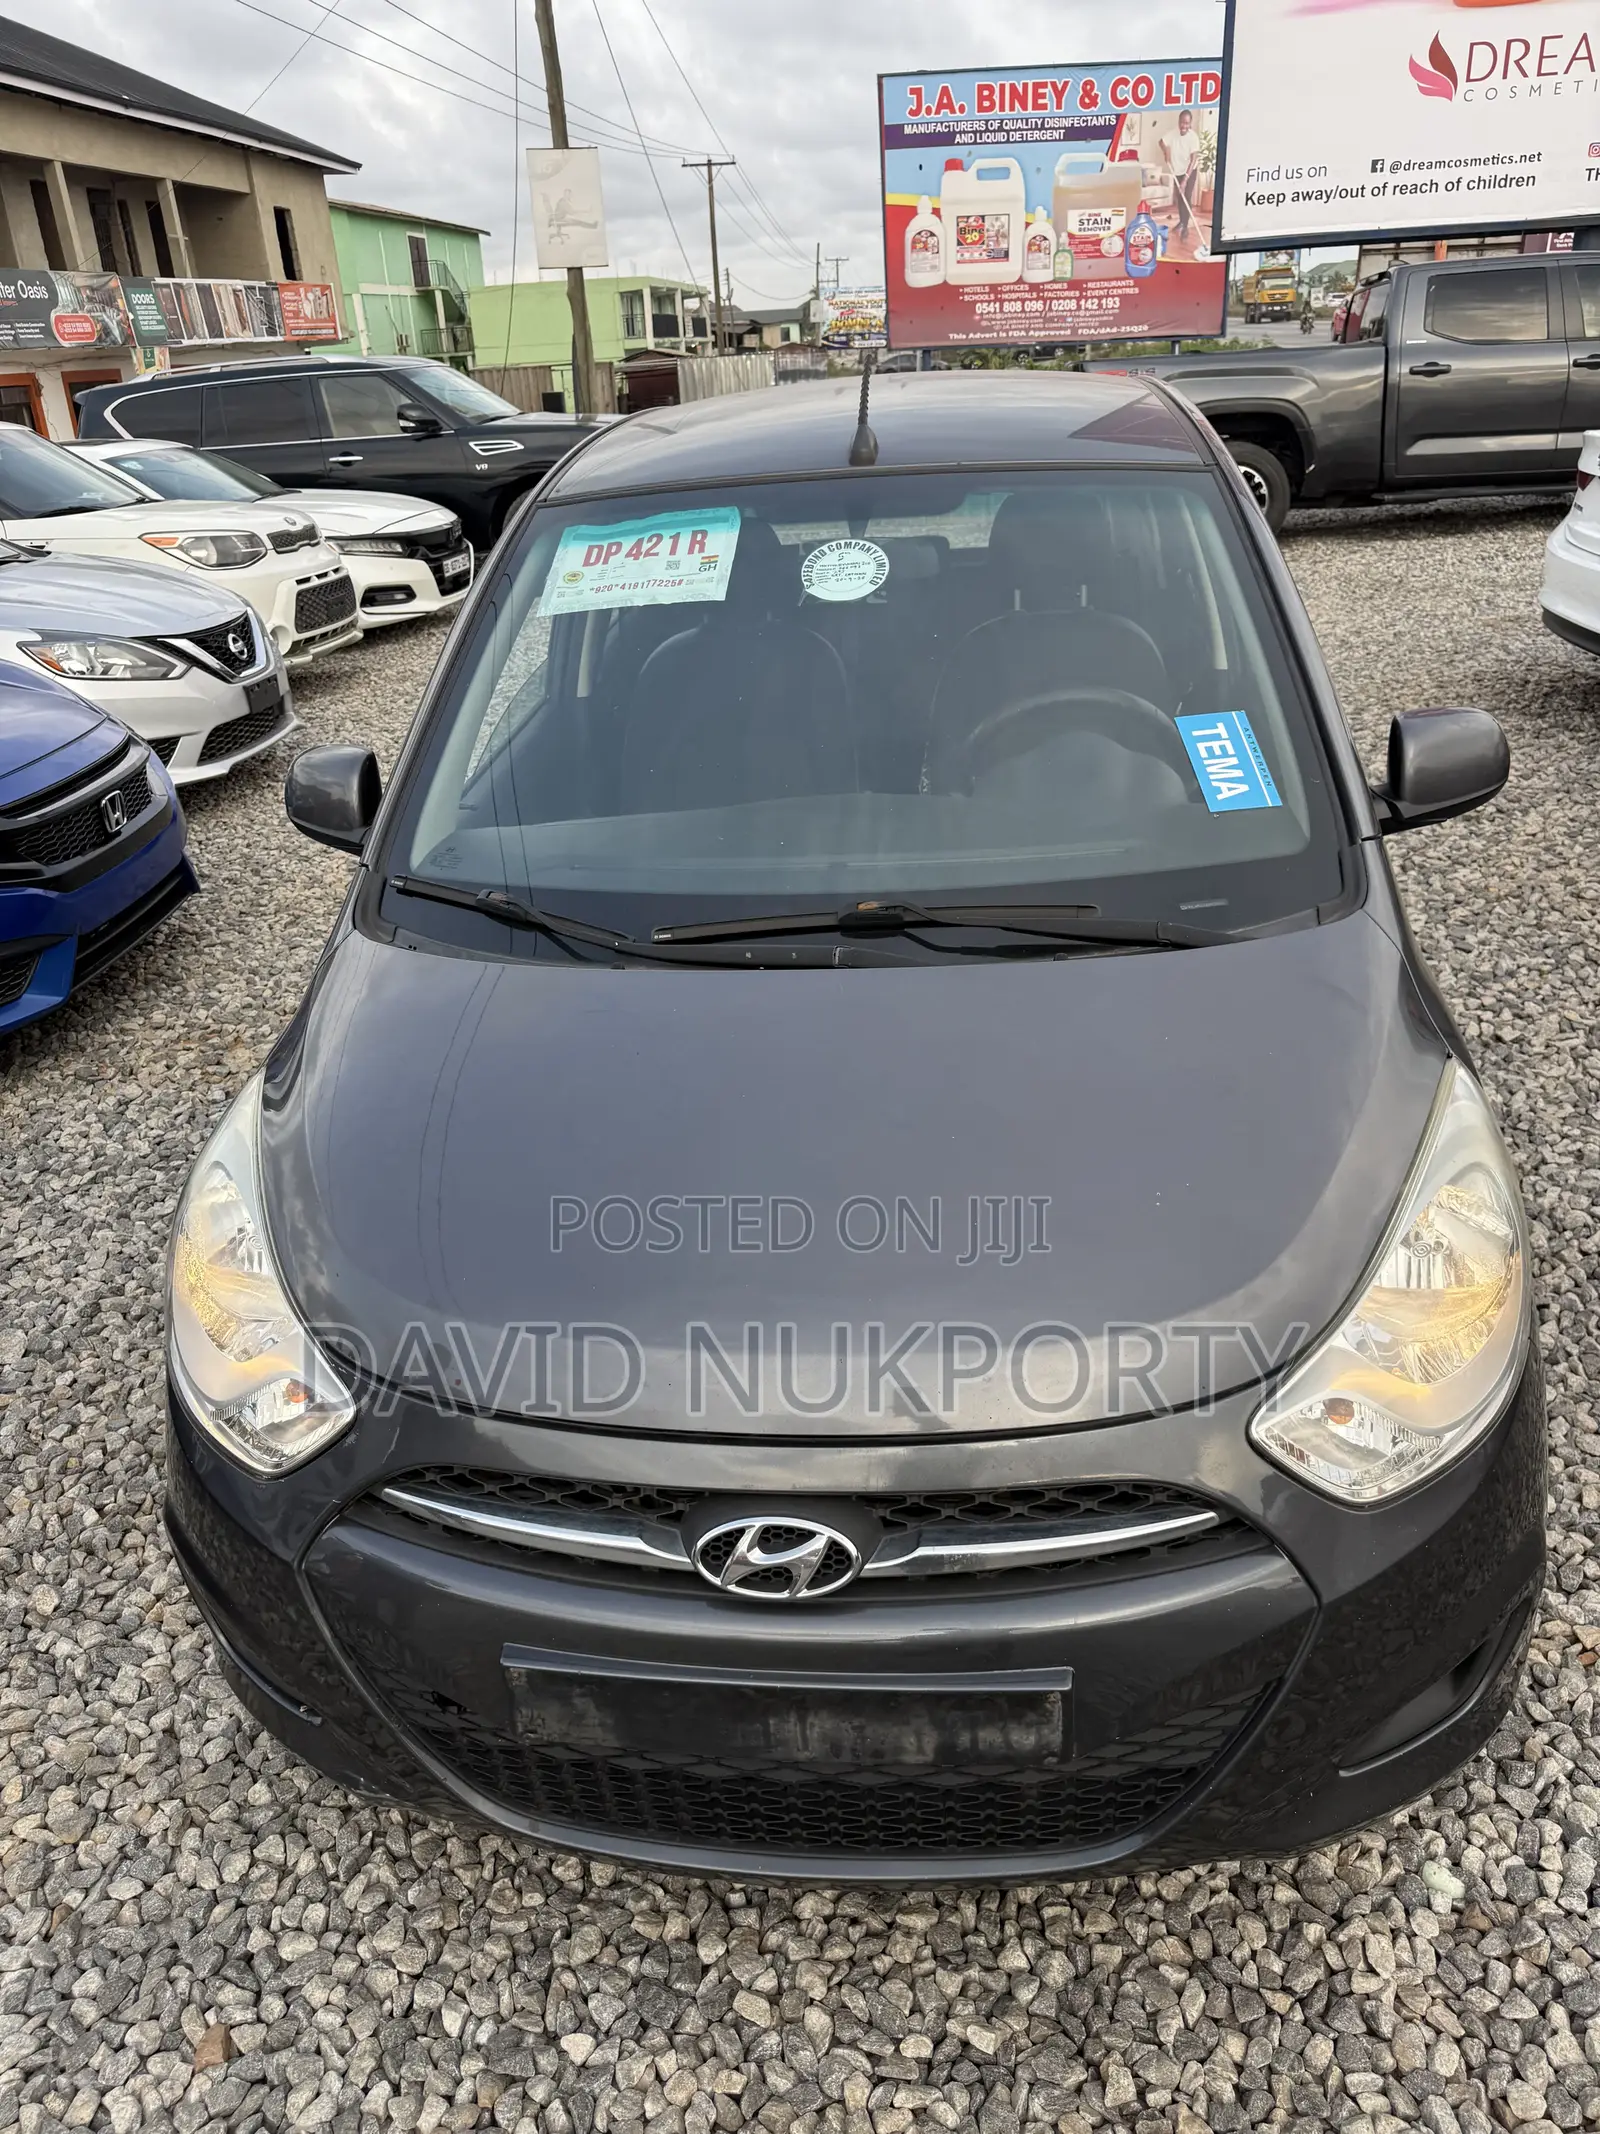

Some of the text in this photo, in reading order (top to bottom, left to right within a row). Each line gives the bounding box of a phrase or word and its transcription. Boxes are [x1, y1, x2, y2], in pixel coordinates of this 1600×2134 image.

[1465, 32, 1596, 83] DREA
[908, 70, 1222, 118] J.A. BINEY & CO LTD
[1463, 79, 1598, 102] COSMETI
[904, 115, 1117, 135] MANUFACTURERS OF QUALITY DISINFECTANTS
[954, 129, 1066, 144] AND LIQUID DETERGENT
[1389, 152, 1543, 174] @dreamcosmetics.net
[1246, 165, 1328, 183] Find us on
[1245, 174, 1536, 207] Keep away/out of reach of children
[1078, 217, 1112, 226] STAIN
[17, 280, 49, 299] Oasis
[1001, 284, 1030, 292] OFFICES
[1044, 282, 1068, 290] HOMES
[1087, 280, 1135, 288] RESTAURANTS
[131, 293, 155, 304] DOORS
[963, 293, 996, 301] SCHOOLS
[1001, 291, 1038, 299] HOSPITALS
[1044, 290, 1080, 298] FACTORIES
[1087, 288, 1108, 297] EVENT
[975, 301, 1000, 313] 0541
[1002, 301, 1022, 313] 808
[1023, 300, 1044, 312] 096
[1051, 298, 1077, 311] 0208
[1079, 298, 1099, 310] 142
[1101, 297, 1120, 309] 193
[968, 331, 998, 339] Advert
[1028, 328, 1072, 337] Approved
[582, 529, 709, 567] DP 421 R
[699, 563, 717, 573] GH
[803, 541, 887, 589] SAFEBOND COMPANY LIMITED
[1191, 722, 1250, 800] TEMA
[1244, 727, 1272, 787] ANTWERPEN
